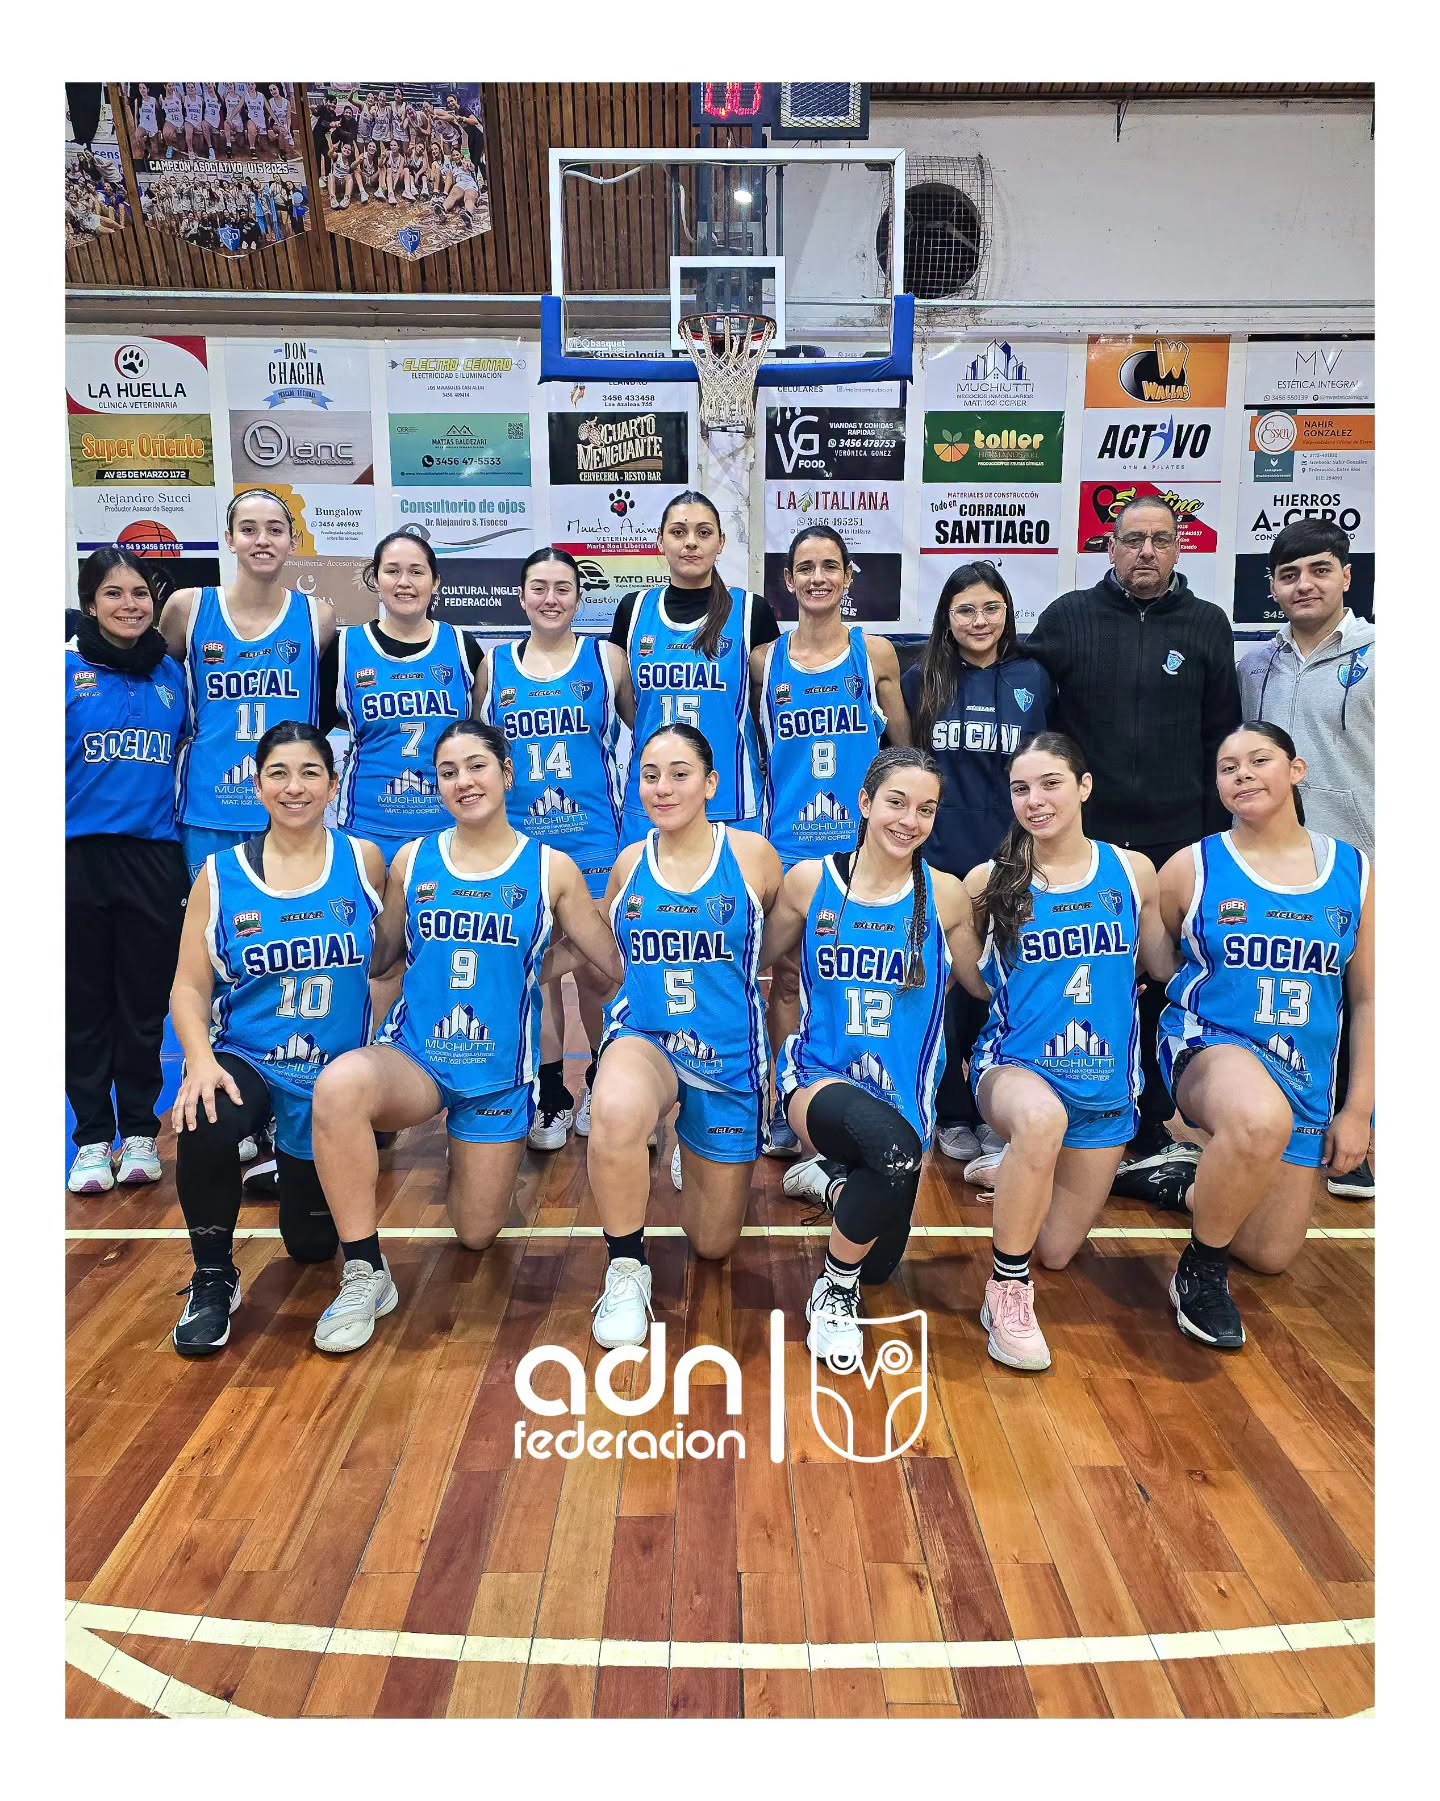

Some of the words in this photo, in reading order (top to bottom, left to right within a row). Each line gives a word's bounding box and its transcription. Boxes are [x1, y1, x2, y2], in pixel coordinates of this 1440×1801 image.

[193, 160, 243, 173] ASOCIATIVO
[265, 163, 288, 173] 2025
[284, 342, 306, 360] DON
[268, 361, 325, 385] CHACHA
[402, 358, 459, 371] ELECTRO
[88, 383, 111, 398] LA
[117, 382, 187, 398] HUELLA
[956, 383, 1035, 392] MUCHIUTTI
[1277, 379, 1315, 389] ESTÉTICA
[600, 413, 656, 444] CUARTO
[81, 433, 135, 461] Super
[138, 432, 206, 458] Oriente
[839, 439, 861, 447] 3456
[863, 439, 896, 447] 478753
[435, 457, 459, 465] 3456
[462, 457, 501, 465] 47-5533
[577, 436, 662, 470] MENGUANTE
[798, 460, 825, 468] FOOD
[103, 471, 115, 479] AV
[116, 471, 128, 479] 25
[128, 471, 139, 479] DE
[139, 471, 169, 479] MARZO
[169, 471, 186, 479] 1172
[579, 472, 619, 481] CERVECERIA
[624, 472, 646, 481] RESTO
[647, 471, 662, 481] BAR
[97, 493, 154, 506] Alejandro
[158, 493, 192, 503] Succi
[400, 499, 476, 514] Consultorio
[479, 499, 495, 514] de
[498, 499, 526, 514] ojos
[777, 491, 797, 510] LA
[814, 491, 890, 510] ITALIANA
[930, 500, 948, 512] Todo
[948, 499, 957, 508] en
[1273, 494, 1341, 506] HIERROS
[315, 507, 363, 517] Bungalow
[959, 504, 1026, 516] CORRALON
[425, 518, 435, 527] Dr.
[435, 518, 471, 527] Alejandro
[480, 518, 508, 527] Tisocco
[567, 518, 611, 534] Mundo
[807, 517, 829, 526] 3456
[935, 520, 1050, 544] SANTIAGO
[441, 586, 488, 595] CULTURAL
[491, 586, 520, 595] INGLE
[444, 596, 502, 606] FEDERACIÓN
[585, 596, 619, 604] Gastón
[1263, 611, 1285, 619] 345
[206, 668, 300, 700] SOCIAL
[638, 662, 726, 691] SOCIAL
[362, 690, 459, 721] SOCIAL
[659, 694, 701, 729] 15
[236, 702, 267, 741] 11
[504, 705, 591, 740] SOCIAL
[777, 705, 868, 740] SOCIAL
[83, 728, 172, 765] SOCIAL
[400, 721, 427, 757] 7
[527, 740, 572, 782] 14
[811, 740, 836, 779] 8
[792, 822, 856, 830] MUCHIUTTI
[1220, 901, 1245, 912] FBER
[234, 912, 259, 925] FBER
[418, 908, 519, 946] SOCIAL
[630, 929, 735, 964] SOCIAL
[1020, 922, 1130, 963] SOCIAL
[242, 932, 365, 978] SOCIAL
[1223, 933, 1340, 976] SOCIAL
[450, 948, 478, 990] 9
[664, 968, 697, 1016] 5
[1063, 963, 1093, 1005] 4
[276, 975, 333, 1019] 10
[1253, 975, 1314, 1027] 13
[845, 987, 894, 1039] 12
[425, 1039, 496, 1051] MUCHIUTTI
[1034, 1058, 1115, 1067] MUCHIUTTI
